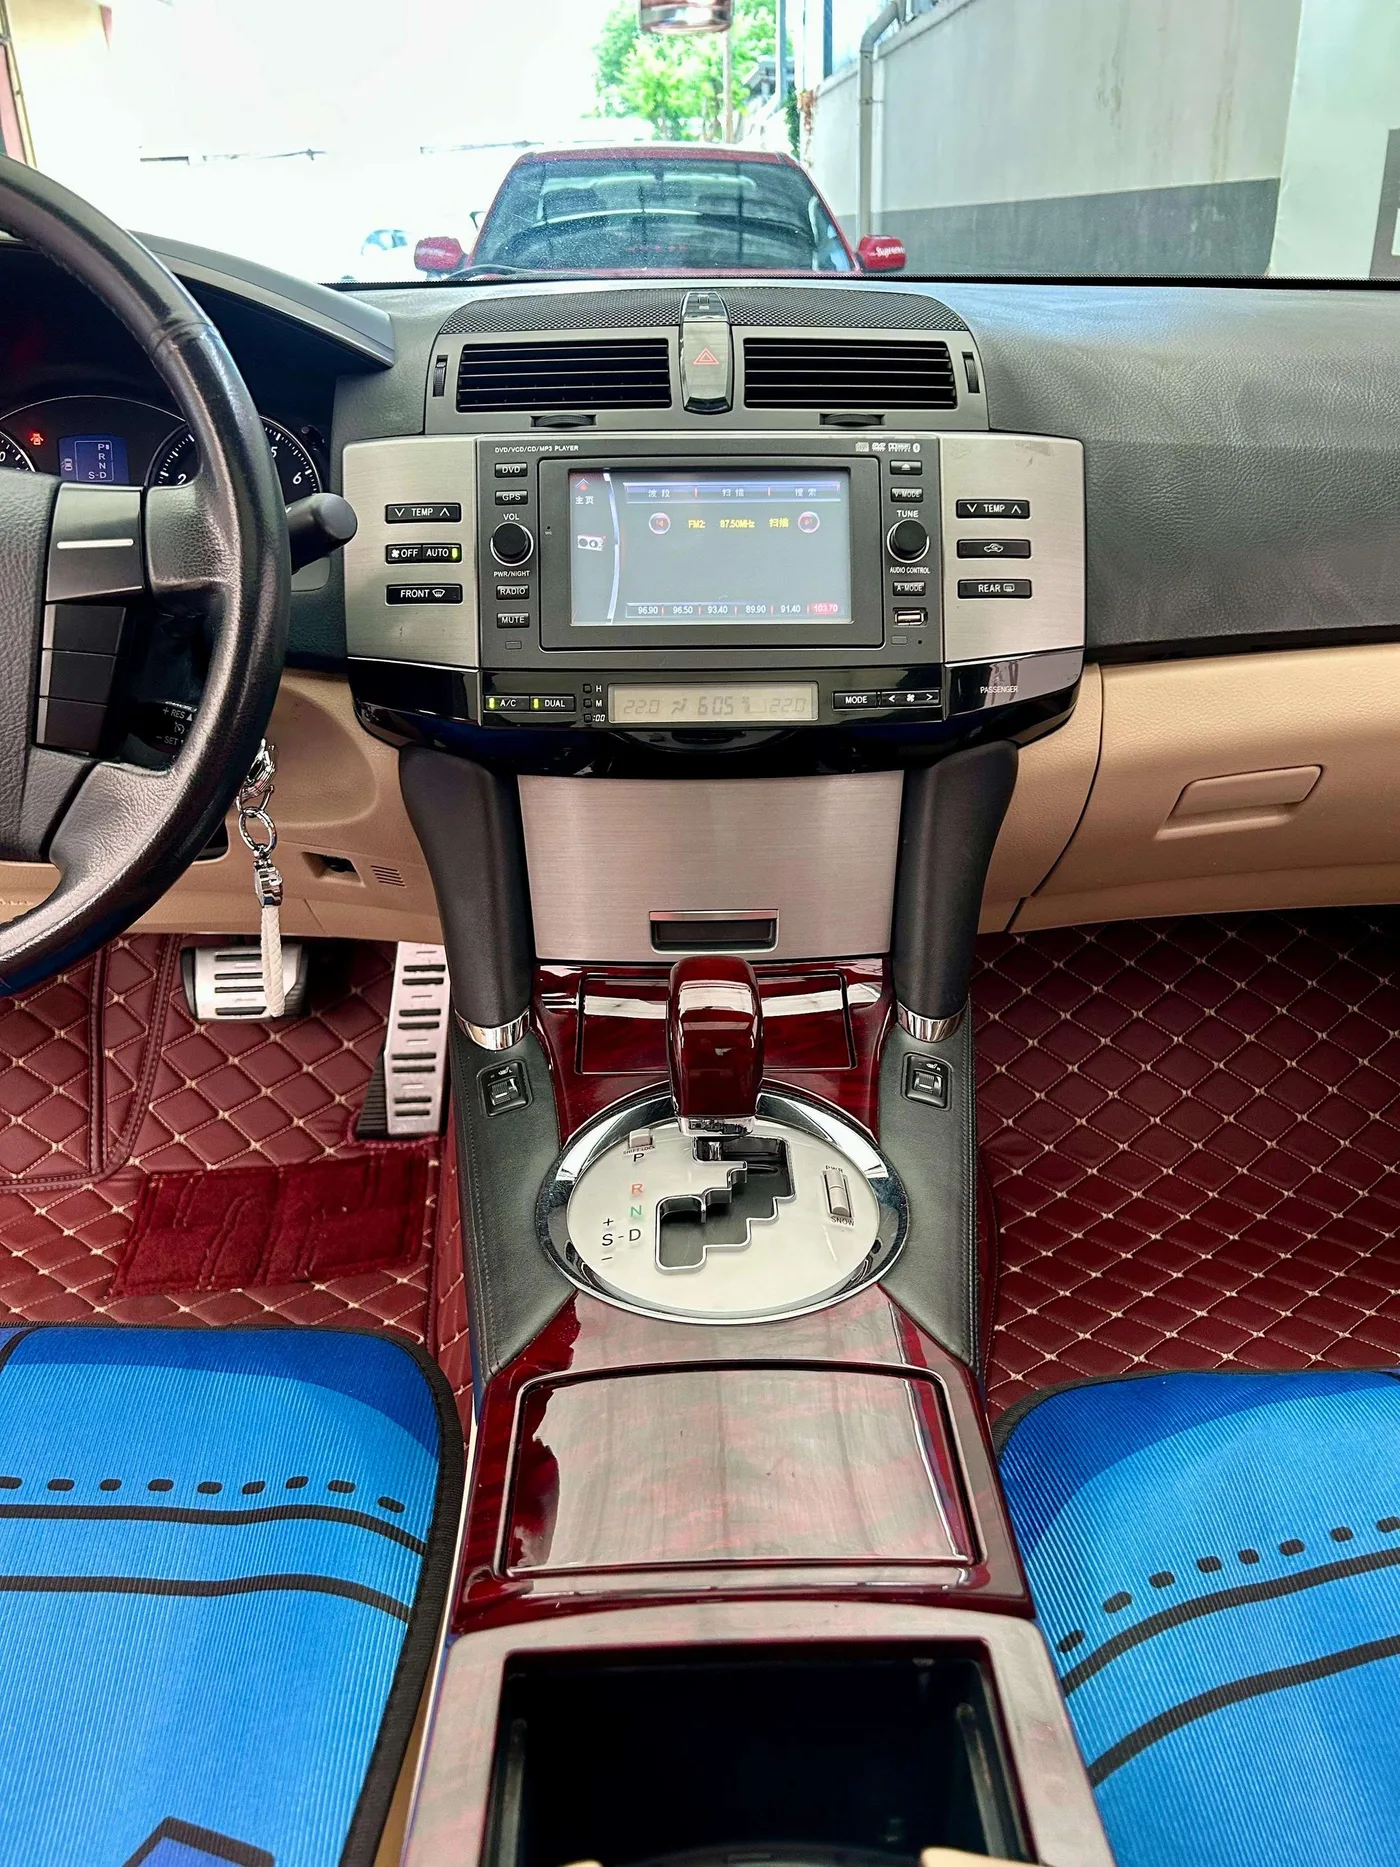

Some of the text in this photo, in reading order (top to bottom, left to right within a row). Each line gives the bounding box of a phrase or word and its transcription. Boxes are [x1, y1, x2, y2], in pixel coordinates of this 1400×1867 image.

[97, 443, 105, 451] P
[494, 445, 553, 453] DVD/VCD/CD/MP3
[502, 466, 521, 474] DVD
[292, 472, 302, 485] 6
[502, 493, 521, 501] GPS
[575, 495, 595, 505] 主页
[411, 507, 434, 517] TEMP
[983, 504, 1006, 513] TEMP
[502, 513, 520, 521] VOL
[896, 509, 920, 518] TUNE
[400, 549, 419, 558] OFF
[426, 548, 449, 557] AUTO
[889, 566, 931, 574] AUDIO CONTROL
[500, 587, 526, 595] RADIO
[896, 584, 923, 592] A-MODE
[978, 584, 1001, 593] REAR
[400, 589, 430, 598] FRONT
[638, 605, 659, 615] 96.90
[672, 605, 693, 615] 96.50
[707, 605, 728, 615] 93.40
[745, 605, 767, 614] 89.90
[780, 604, 801, 614] 91.40
[501, 615, 525, 624] MUTE
[595, 685, 602, 693] H
[979, 685, 1019, 694] PASSENGER
[500, 699, 517, 707] A/C
[544, 699, 566, 708] DUAL
[845, 695, 868, 704] MODE
[170, 709, 186, 719] RES
[164, 736, 179, 746] SET
[641, 1144, 656, 1152] LOCK
[633, 1152, 645, 1162] P
[631, 1183, 643, 1195] R
[630, 1205, 642, 1217] N
[830, 1215, 855, 1227] SNOW
